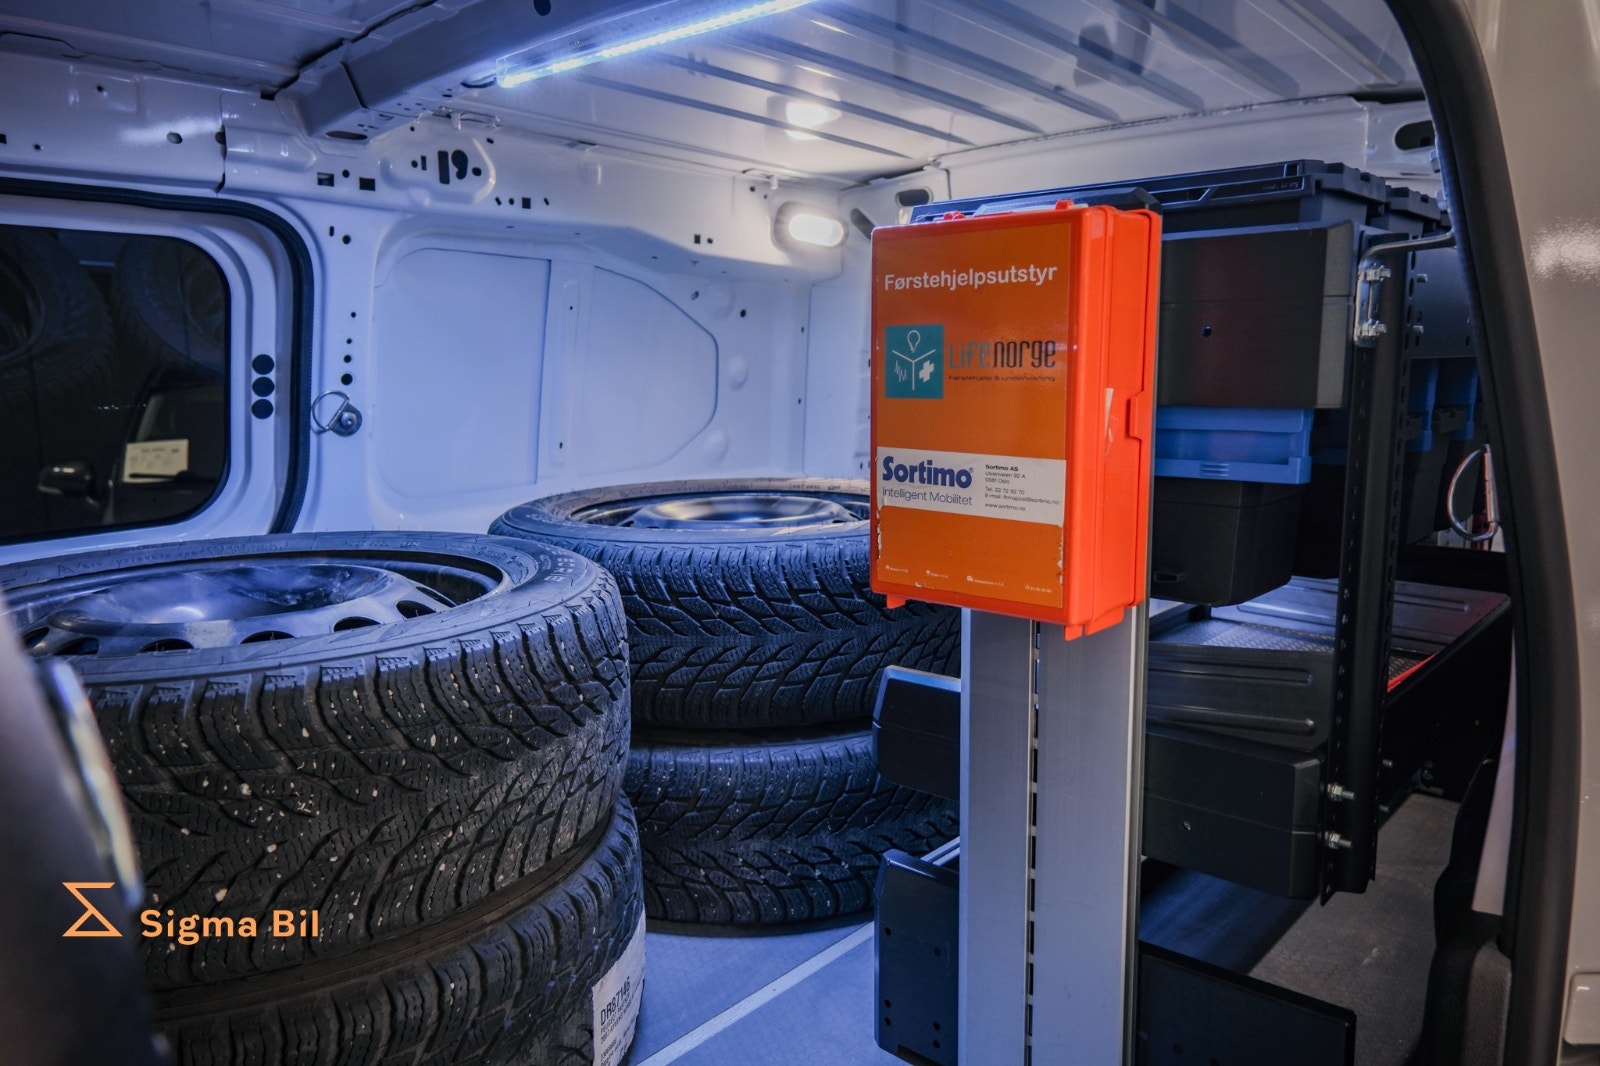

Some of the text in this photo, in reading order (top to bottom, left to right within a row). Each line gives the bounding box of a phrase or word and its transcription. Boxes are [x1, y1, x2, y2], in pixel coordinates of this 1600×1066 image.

[884, 264, 1058, 291] Førstehjelpsutstyr
[882, 486, 973, 506] Intelligent Mobilitet
